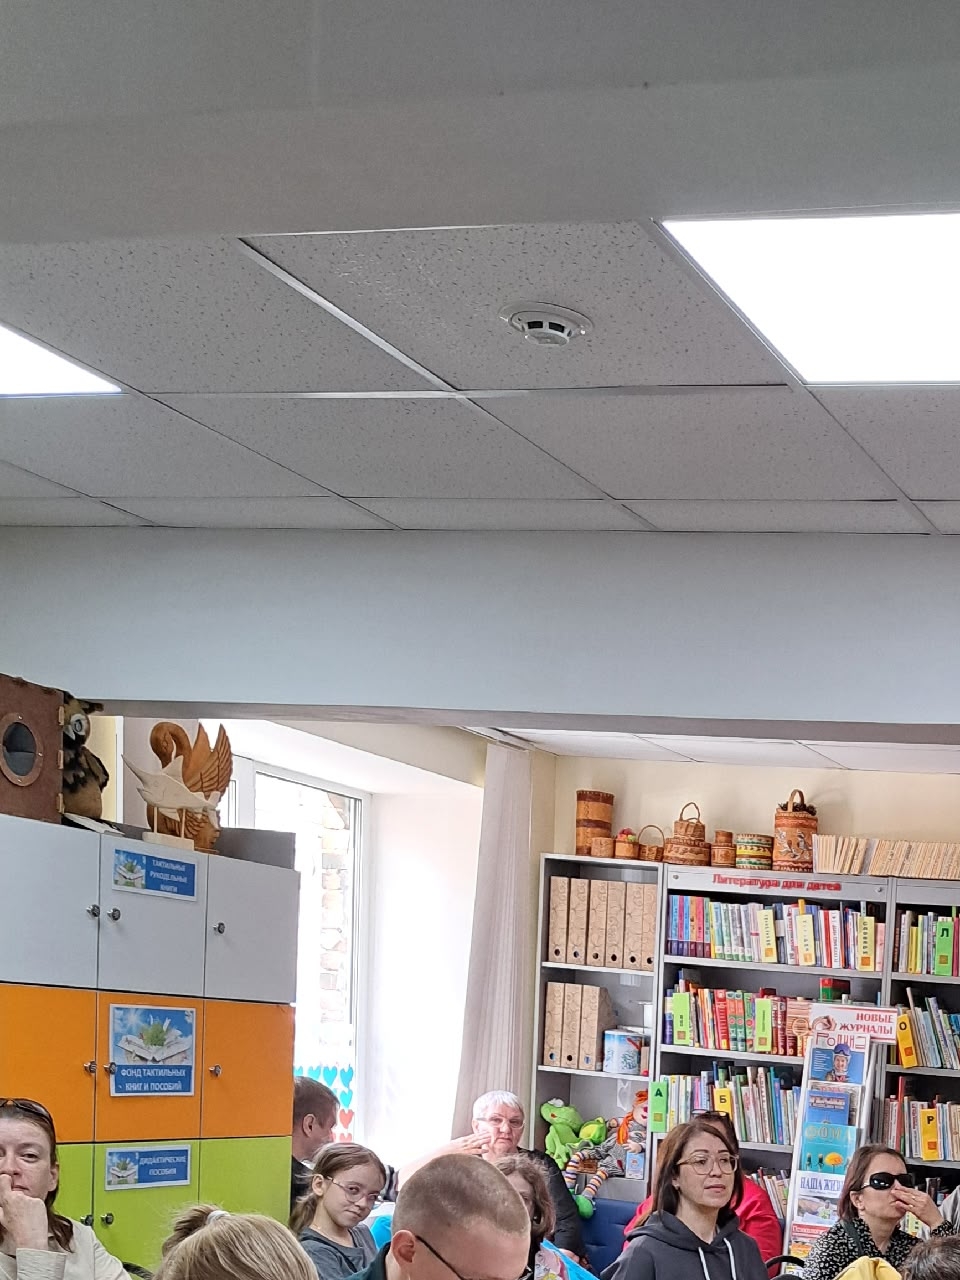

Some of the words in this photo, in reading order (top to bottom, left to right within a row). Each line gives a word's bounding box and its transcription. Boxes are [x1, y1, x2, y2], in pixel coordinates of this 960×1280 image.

[713, 874, 780, 890] Литература
[781, 880, 805, 890] для
[806, 881, 842, 891] детей
[856, 1013, 894, 1023] НОВЫЕ
[840, 1022, 893, 1035] ЖУРНАЛЫ
[121, 1068, 142, 1078] ФОНД
[143, 1068, 186, 1077] ТАКТИЛЬНЫХ
[125, 1082, 142, 1091] КНИГ
[150, 1080, 182, 1091] ПОСОБИЙ
[654, 1087, 664, 1098] А
[719, 1094, 728, 1104] Б
[926, 1115, 935, 1125] Р
